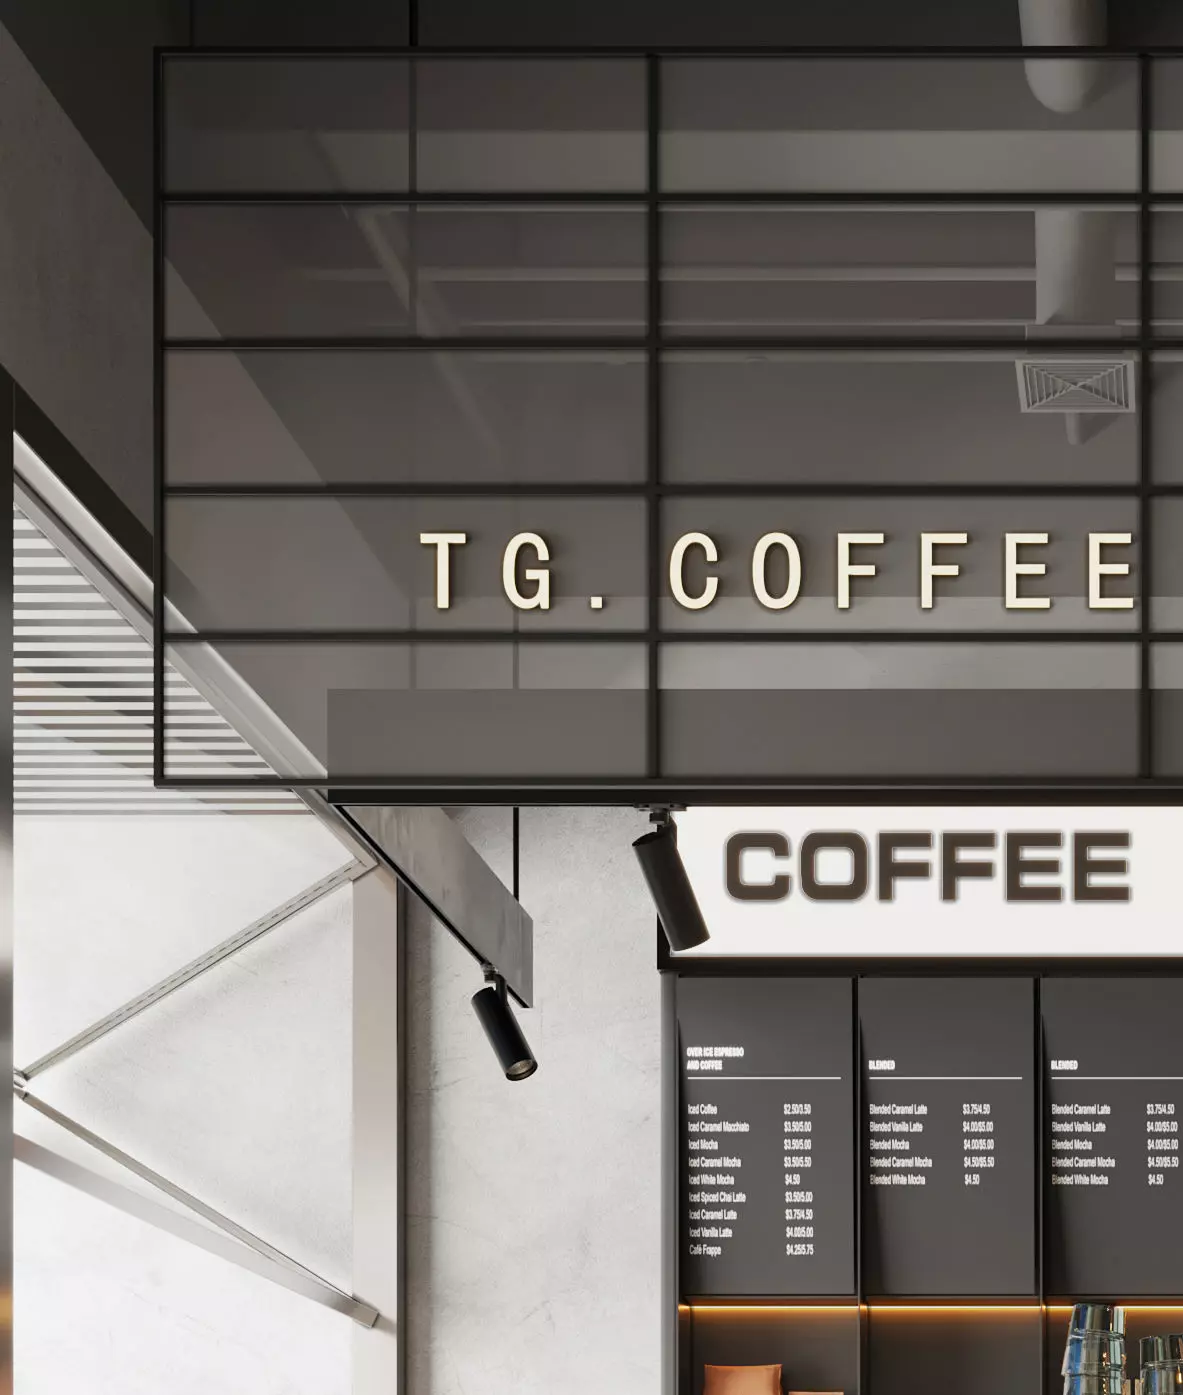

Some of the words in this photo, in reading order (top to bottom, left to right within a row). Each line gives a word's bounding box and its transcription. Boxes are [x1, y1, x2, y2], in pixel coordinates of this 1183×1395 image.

[726, 831, 1130, 903] COFFEE
[686, 1047, 702, 1057] OVER
[704, 1047, 713, 1057] ICE
[714, 1047, 744, 1057] ESPRESSO
[686, 1060, 699, 1070] AND
[700, 1060, 722, 1070] COFFEE
[868, 1060, 895, 1070] BLENDED
[1051, 1060, 1078, 1070] BLENDED
[870, 1104, 890, 1114] Blended
[892, 1104, 913, 1114] Caramel
[914, 1104, 928, 1114] Latte
[870, 1122, 891, 1132] Blended
[892, 1122, 908, 1132] Vanilla
[910, 1122, 923, 1132] Latte
[870, 1139, 890, 1150] Blended
[892, 1139, 910, 1150] Mocha
[870, 1157, 891, 1167] Blended
[892, 1157, 914, 1167] Caramel
[915, 1157, 932, 1167] Mocha
[870, 1174, 891, 1184] Blended
[892, 1174, 906, 1185] White
[908, 1174, 926, 1184] Mocha
[964, 1174, 980, 1185] $4.50
